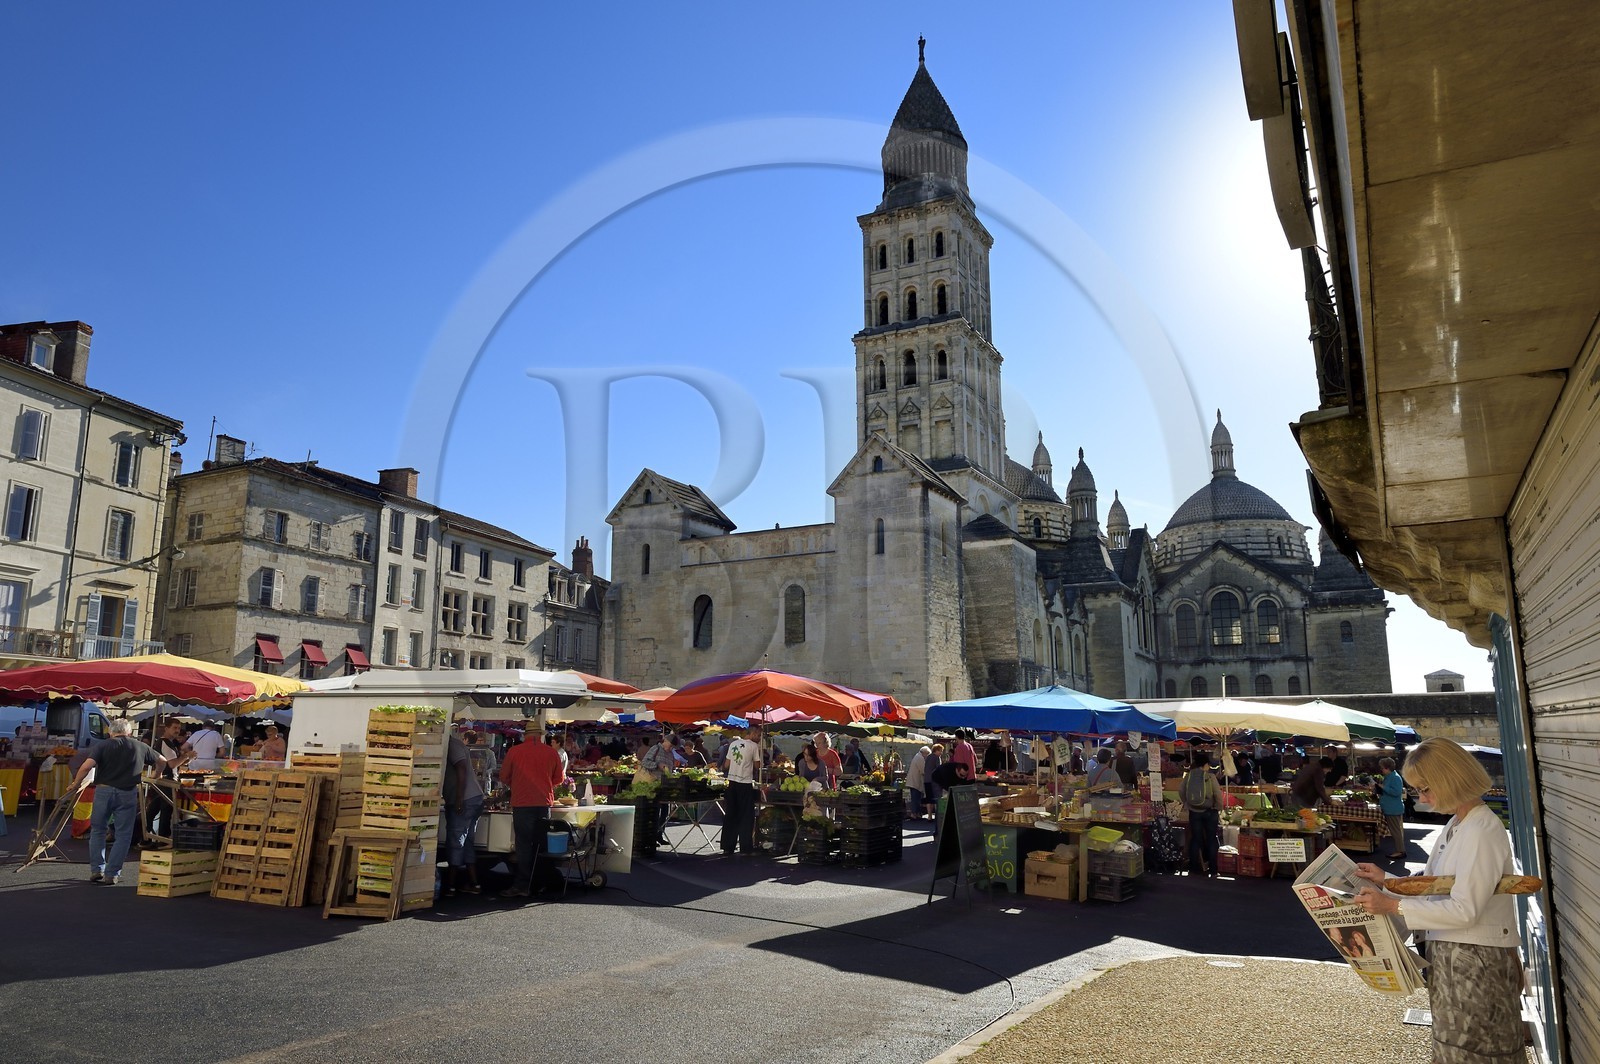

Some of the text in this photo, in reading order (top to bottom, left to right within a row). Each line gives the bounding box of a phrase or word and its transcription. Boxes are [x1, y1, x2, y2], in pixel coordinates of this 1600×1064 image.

[495, 695, 554, 705] KANOVERA
[1300, 887, 1319, 898] SUD
[1306, 895, 1332, 908] OUEST
[1348, 906, 1368, 915] régio
[1319, 918, 1342, 926] promise
[1351, 914, 1376, 925] gauche
